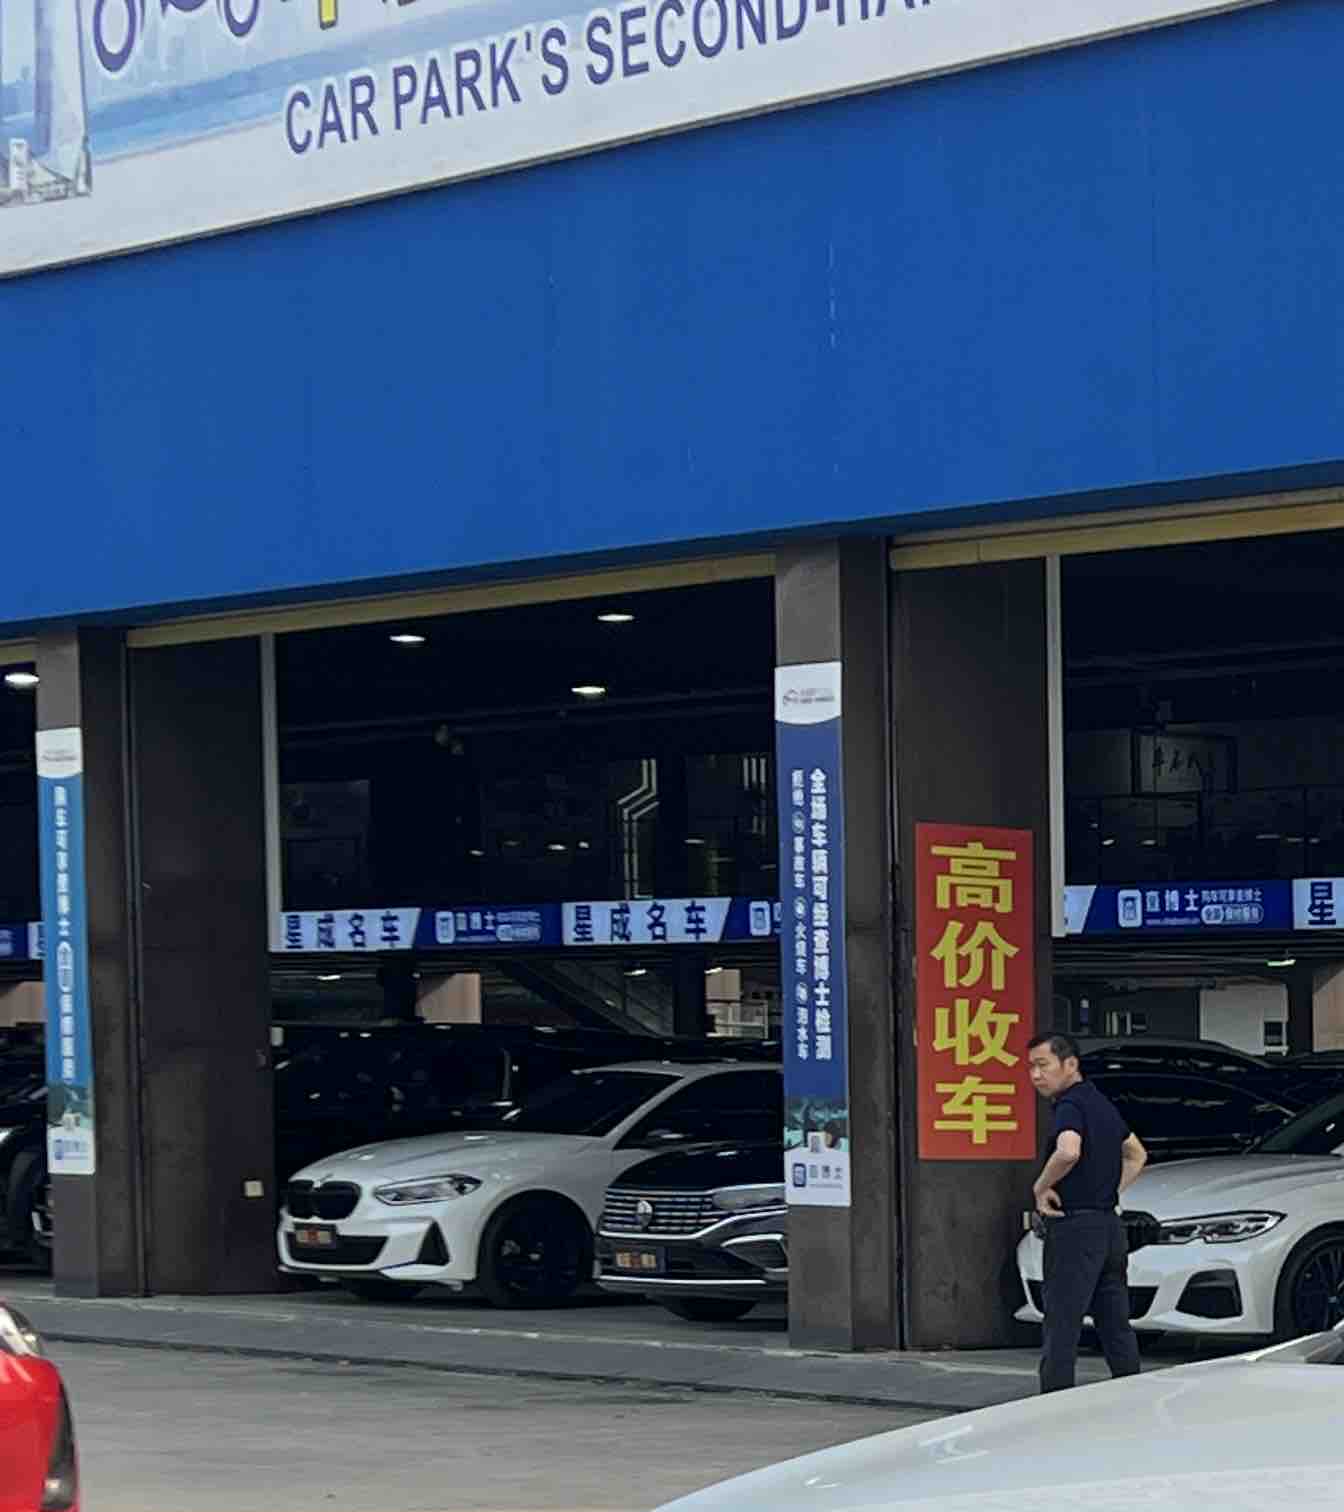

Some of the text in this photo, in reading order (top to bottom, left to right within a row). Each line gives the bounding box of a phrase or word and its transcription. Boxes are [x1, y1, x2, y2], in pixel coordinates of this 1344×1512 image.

[285, 72, 378, 154] CAR
[392, 27, 568, 131] PARK'S
[585, 0, 934, 85] SECOND-
[574, 902, 707, 943] 星成名车
[930, 842, 1020, 1145] 高价收车
